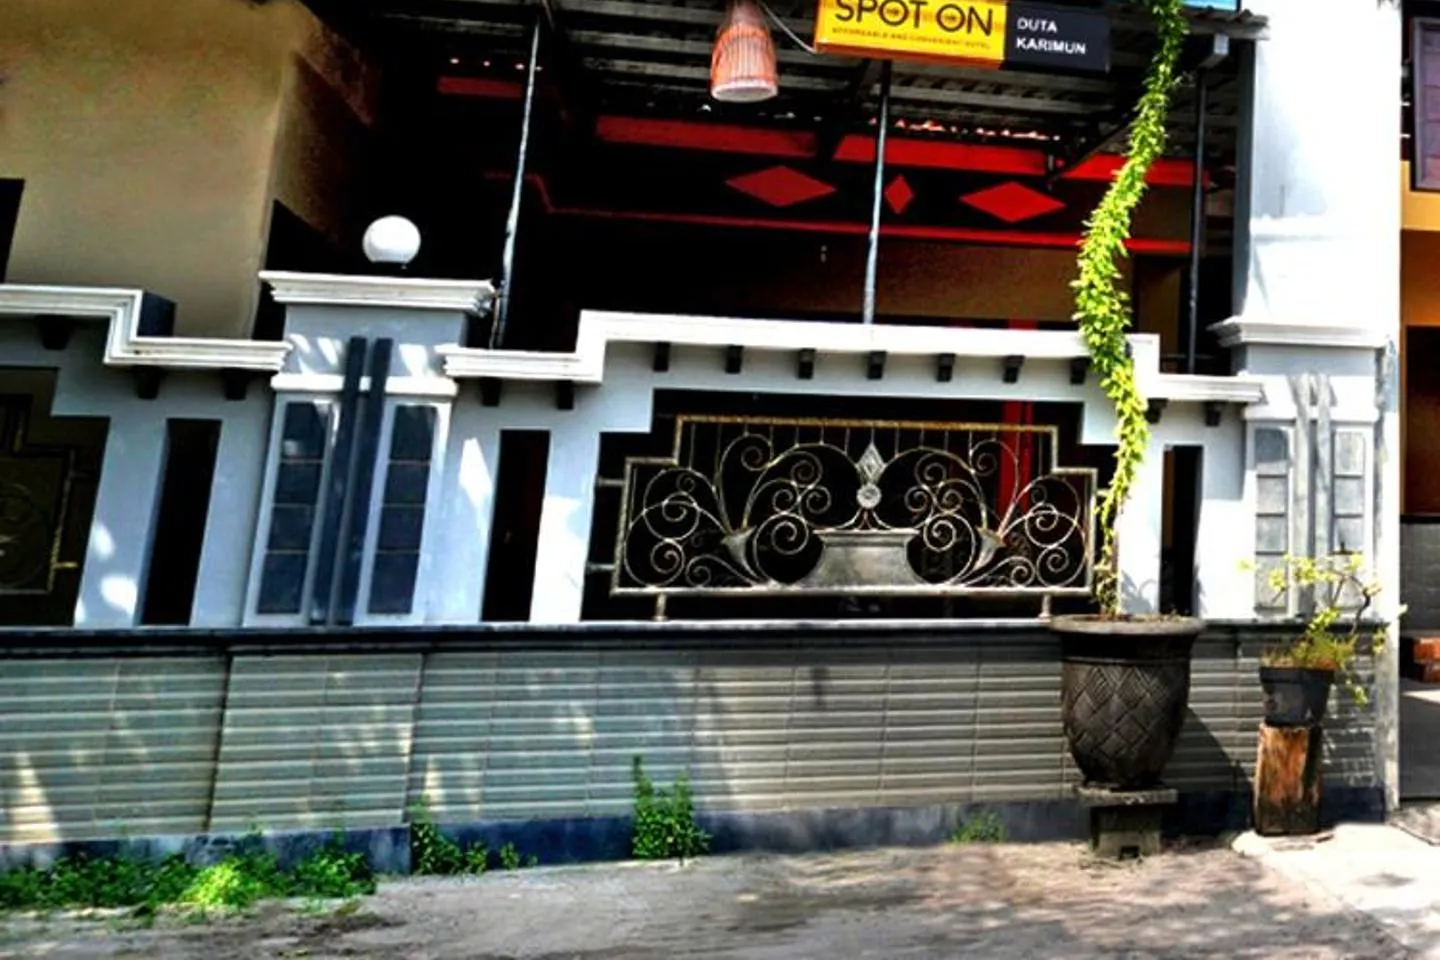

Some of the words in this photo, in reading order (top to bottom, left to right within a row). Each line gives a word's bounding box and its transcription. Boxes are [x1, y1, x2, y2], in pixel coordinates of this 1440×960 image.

[936, 3, 993, 37] ON
[1017, 17, 1058, 33] DUTA
[1016, 38, 1086, 55] KARIMUN
